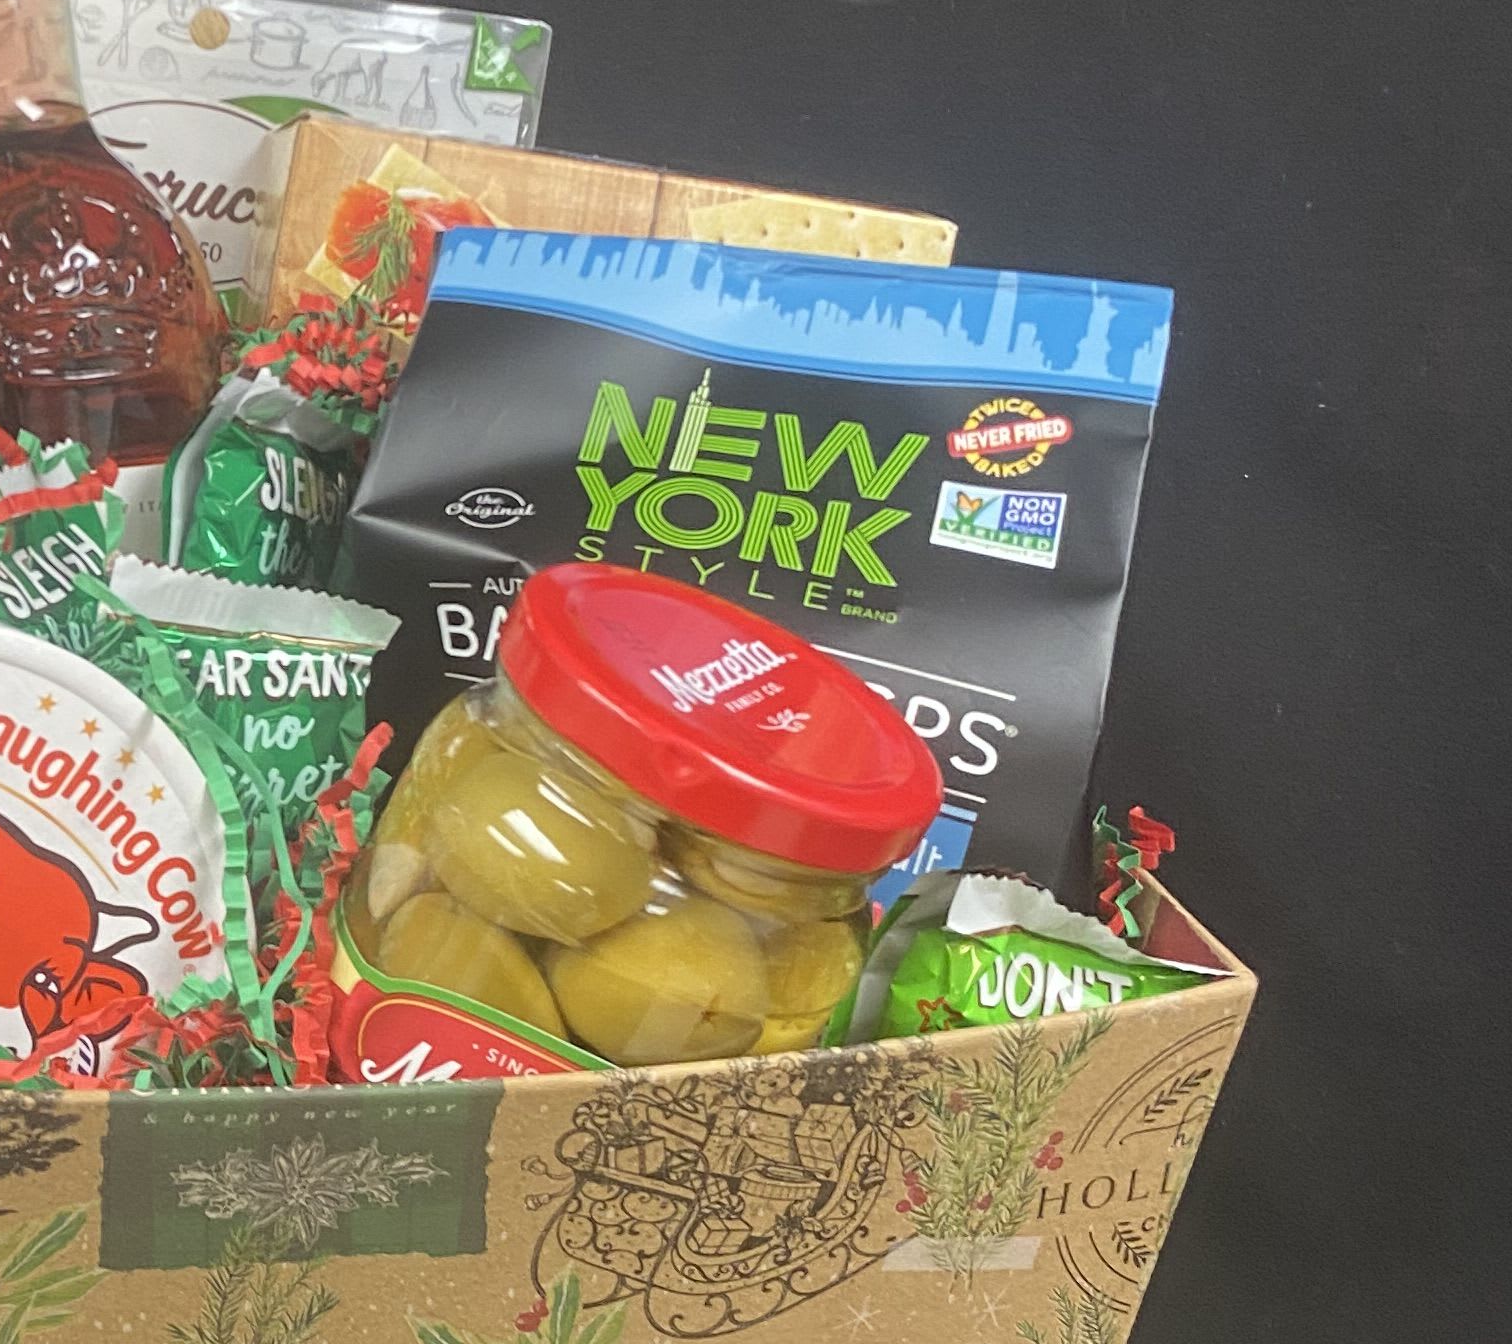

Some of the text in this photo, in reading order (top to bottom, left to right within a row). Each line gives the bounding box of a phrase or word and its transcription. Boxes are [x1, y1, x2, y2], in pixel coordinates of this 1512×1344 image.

[973, 397, 1037, 422] TWICE
[577, 368, 930, 501] NEW
[953, 418, 1068, 452] NEVER FRIED
[973, 452, 1045, 479] BAKED
[444, 501, 537, 519] Original
[1004, 510, 1056, 526] GMO
[1007, 496, 1057, 513] NON
[575, 465, 912, 588] YORK
[945, 520, 1052, 552] VERIFIED
[573, 536, 833, 610] STYLE
[840, 602, 898, 624] BRAND
[178, 648, 373, 700] AR SANT
[650, 639, 787, 713] Mezzetta
[243, 713, 316, 753] no
[147, 857, 215, 960] Cow
[486, 1047, 539, 1078] SINC
[182, 1110, 281, 1128] happy
[303, 1108, 361, 1121] new
[382, 1103, 457, 1121] year
[1036, 1160, 1174, 1220] HOLL
